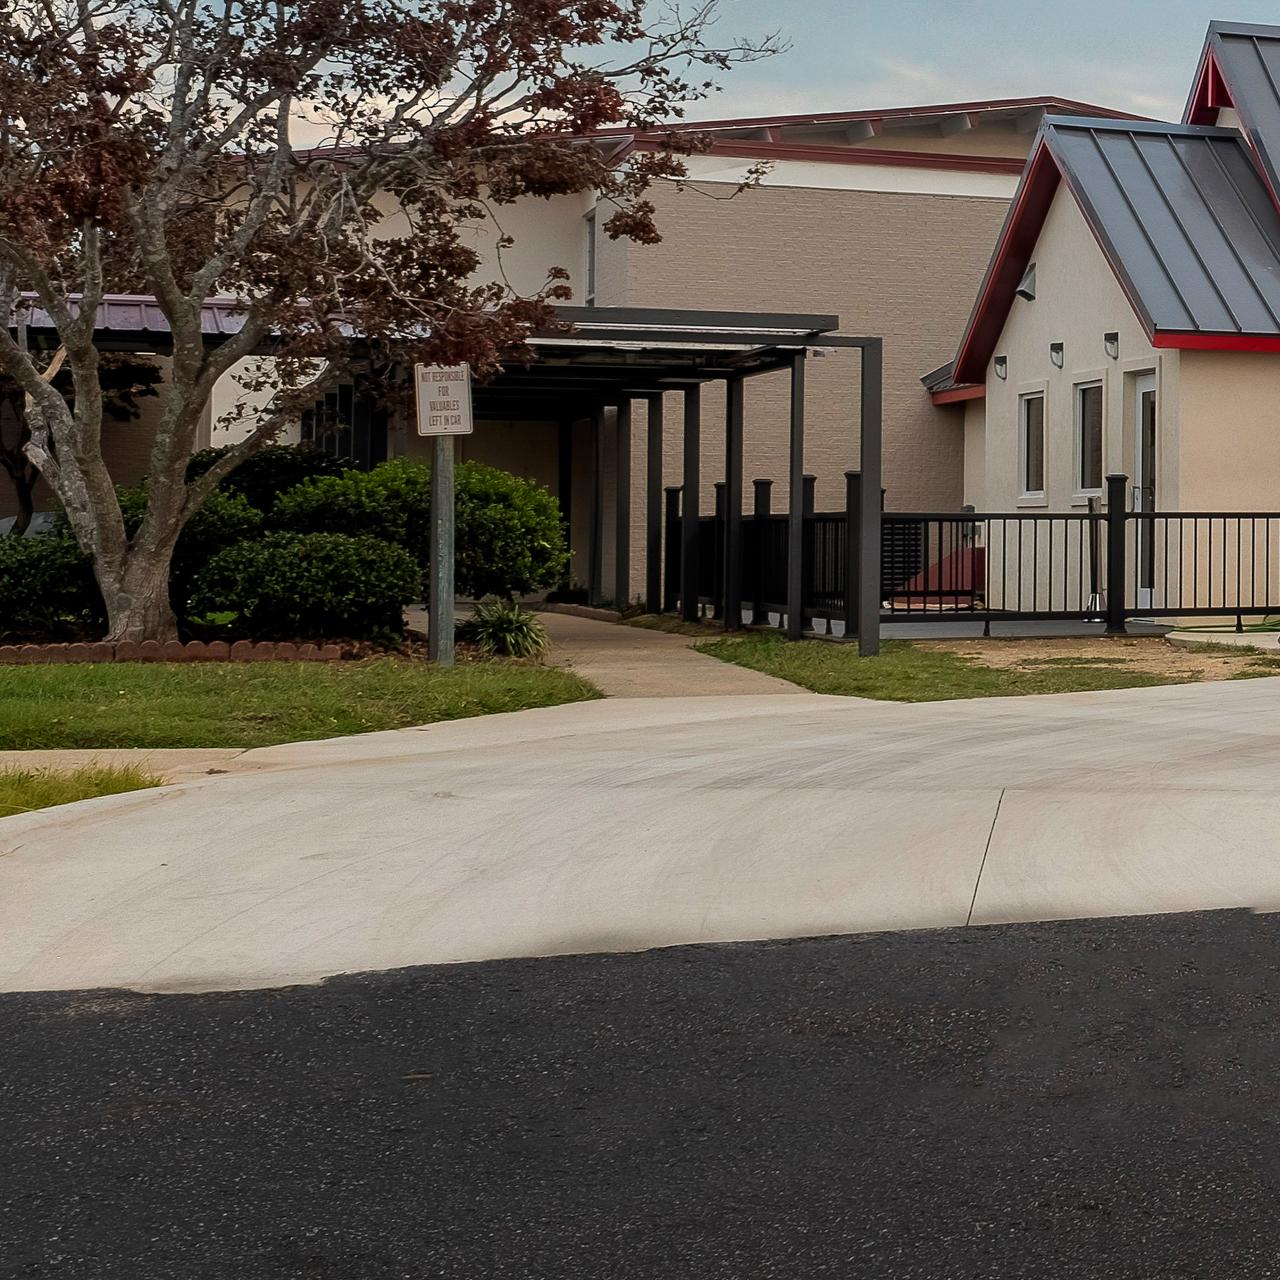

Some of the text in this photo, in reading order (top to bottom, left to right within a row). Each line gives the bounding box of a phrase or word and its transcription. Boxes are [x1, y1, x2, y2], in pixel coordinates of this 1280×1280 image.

[421, 371, 464, 382] NOT RESPONSIBLE
[438, 385, 449, 396] FOR
[429, 400, 459, 411] VALUABLES
[429, 415, 461, 426] LEFT IN CAR
